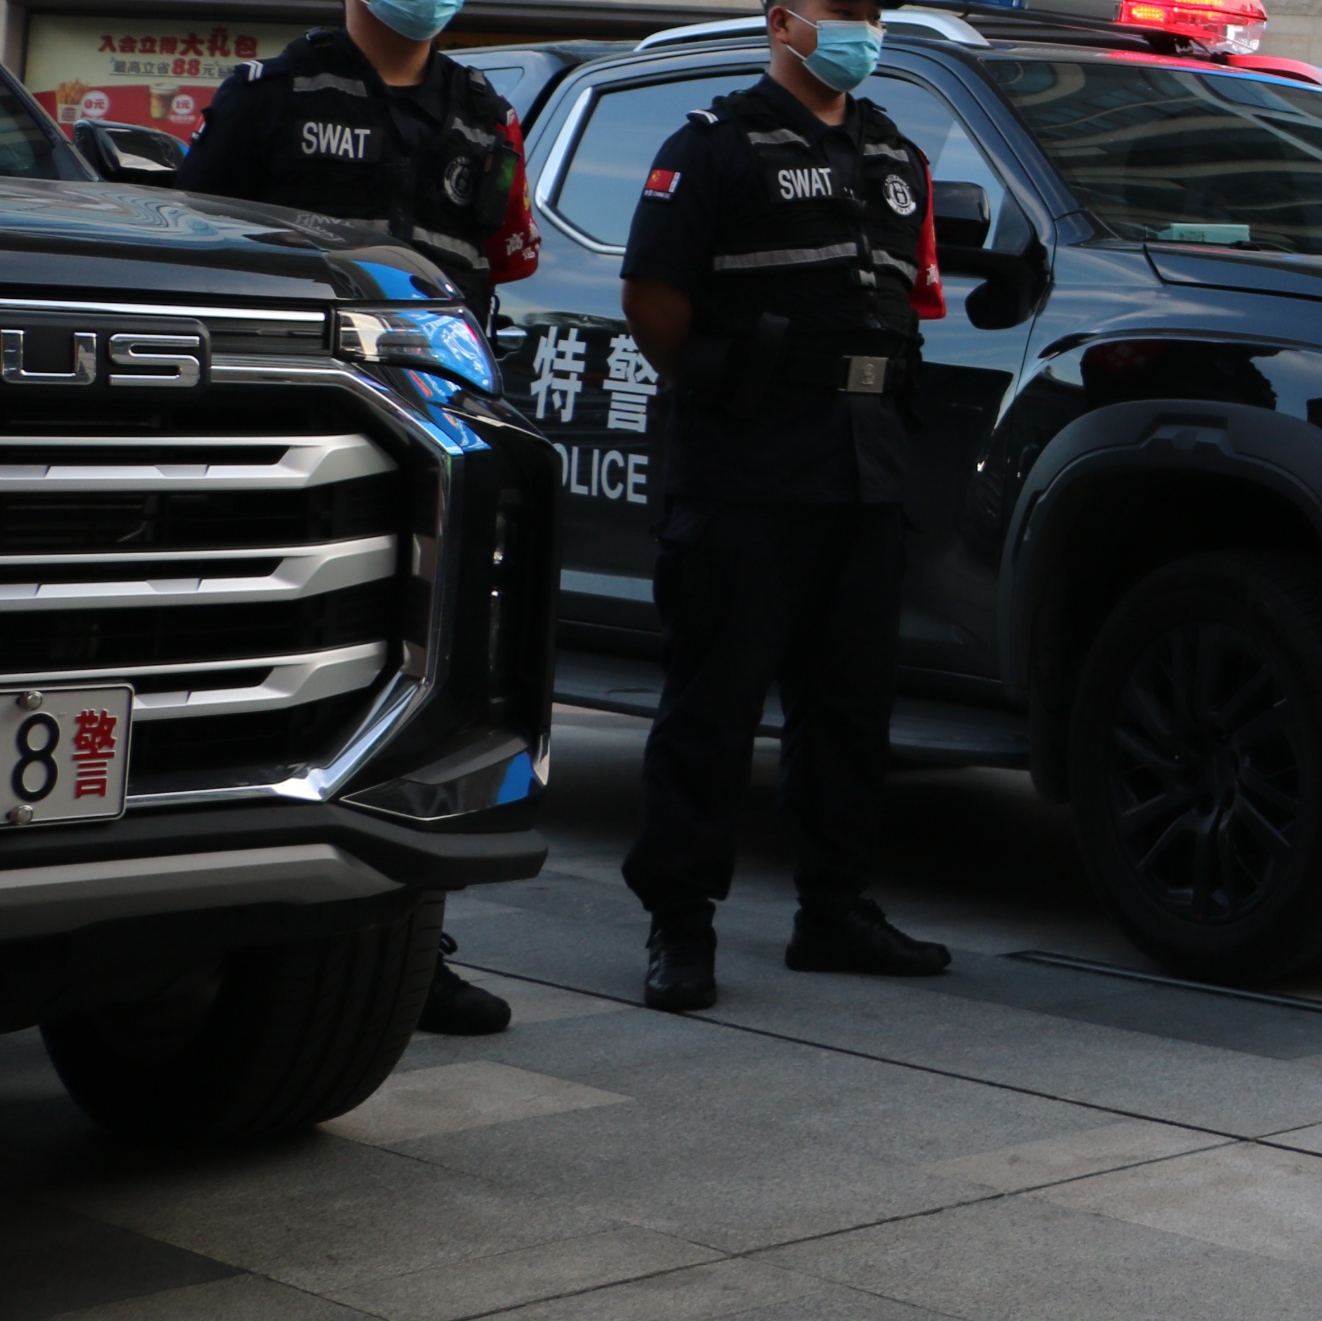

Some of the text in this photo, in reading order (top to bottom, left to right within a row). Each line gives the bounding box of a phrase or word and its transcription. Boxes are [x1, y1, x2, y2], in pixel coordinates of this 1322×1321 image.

[301, 121, 371, 159] SWAT
[777, 167, 834, 200] SWAT
[530, 325, 659, 433] 特警
